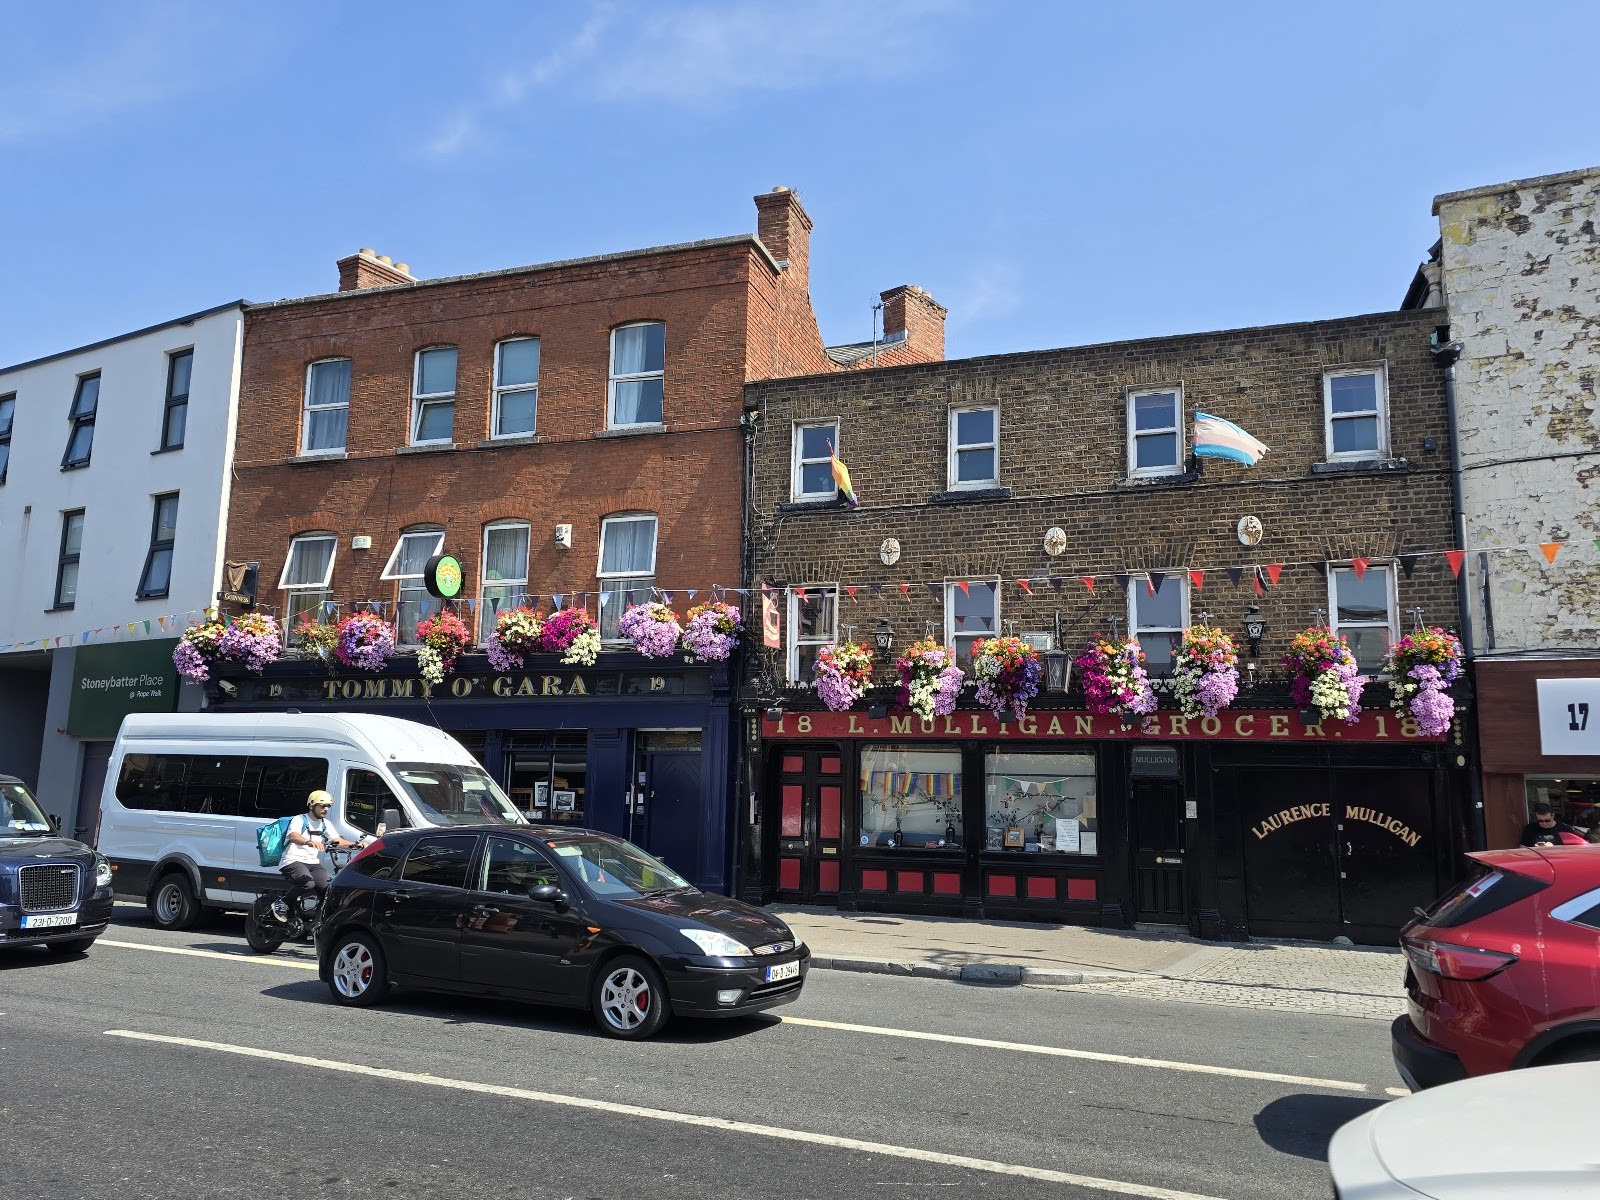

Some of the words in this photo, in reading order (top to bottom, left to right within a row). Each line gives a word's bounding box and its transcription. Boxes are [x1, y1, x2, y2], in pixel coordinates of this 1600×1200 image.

[81, 676, 138, 691] Stoneybatter
[139, 674, 163, 687] Place
[268, 683, 283, 697] 19
[323, 678, 435, 699] TOMMY
[492, 675, 591, 697] GARA
[649, 676, 666, 691] 19
[775, 715, 813, 734] 18
[1375, 715, 1420, 737] 18
[1567, 703, 1589, 731] 17
[1135, 756, 1174, 764] MULLIGAN
[1251, 803, 1331, 840] LAURENCE
[1345, 805, 1422, 847] MULLIGAN
